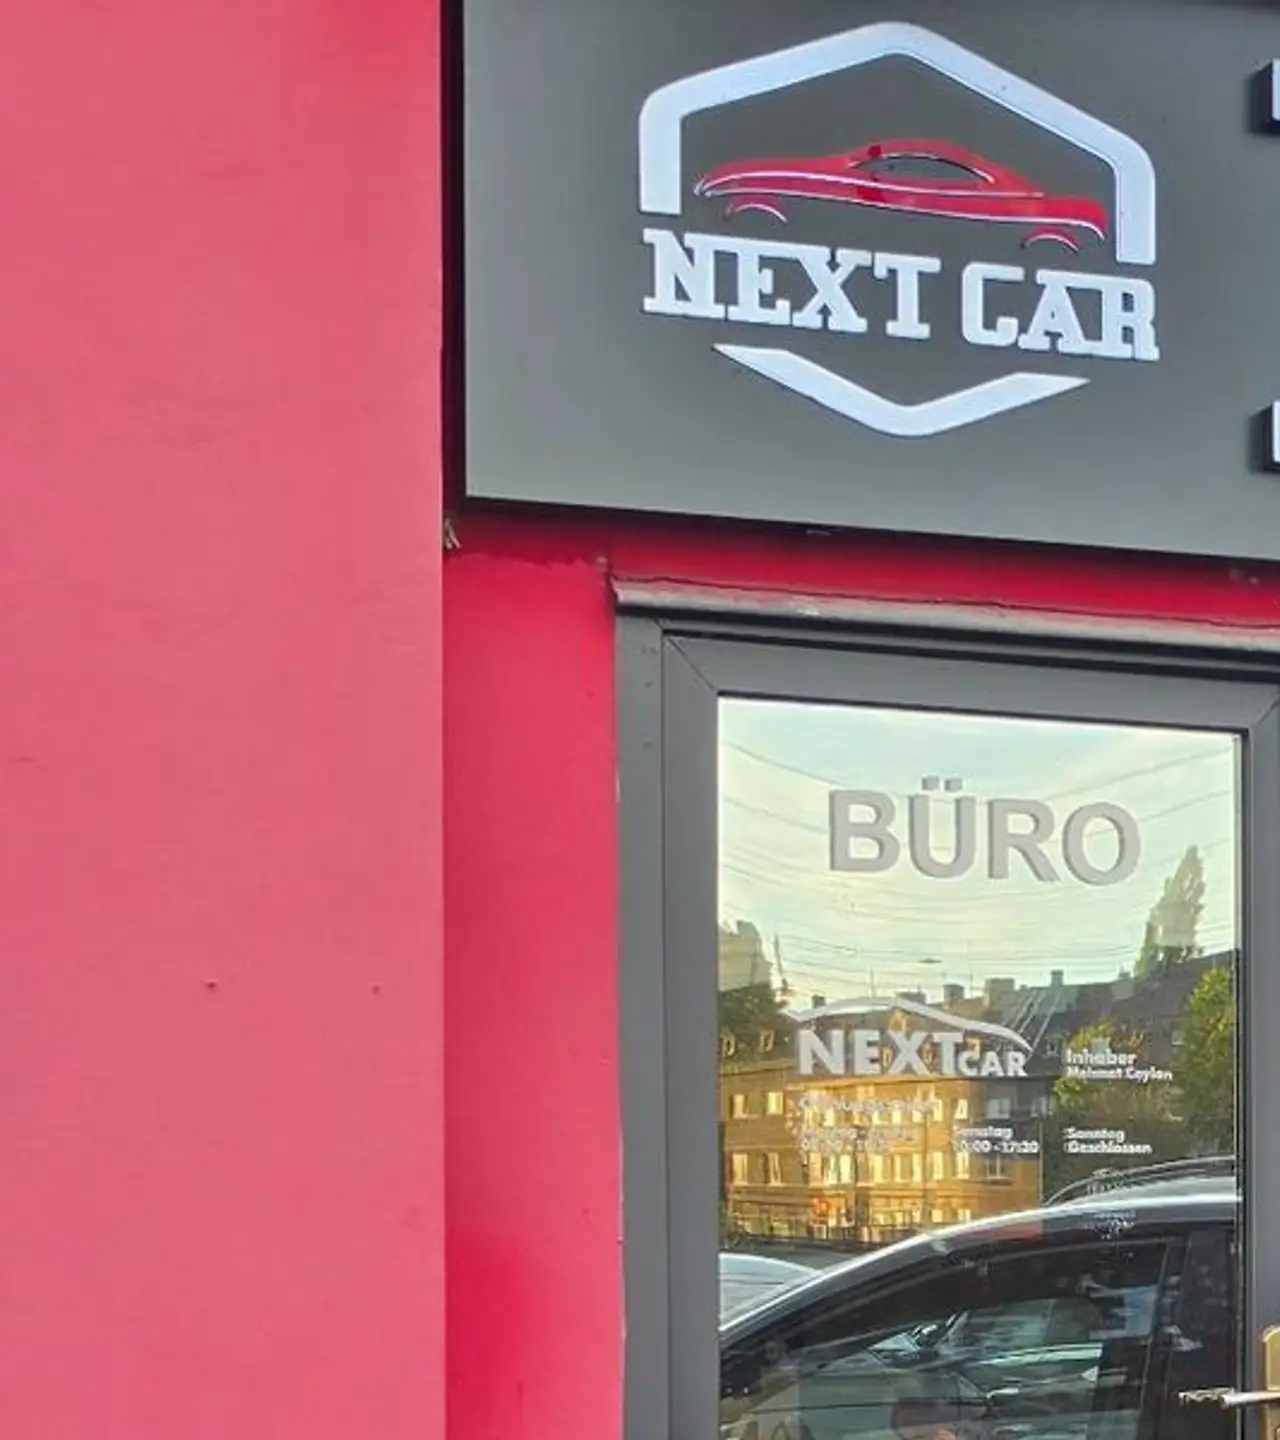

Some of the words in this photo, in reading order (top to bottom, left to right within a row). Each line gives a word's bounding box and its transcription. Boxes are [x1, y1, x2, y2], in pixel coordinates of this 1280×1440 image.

[642, 228, 941, 340] NEXT
[960, 261, 1160, 361] CAR
[828, 774, 1142, 887] BÜRO
[1066, 1048, 1138, 1066] Inhaber
